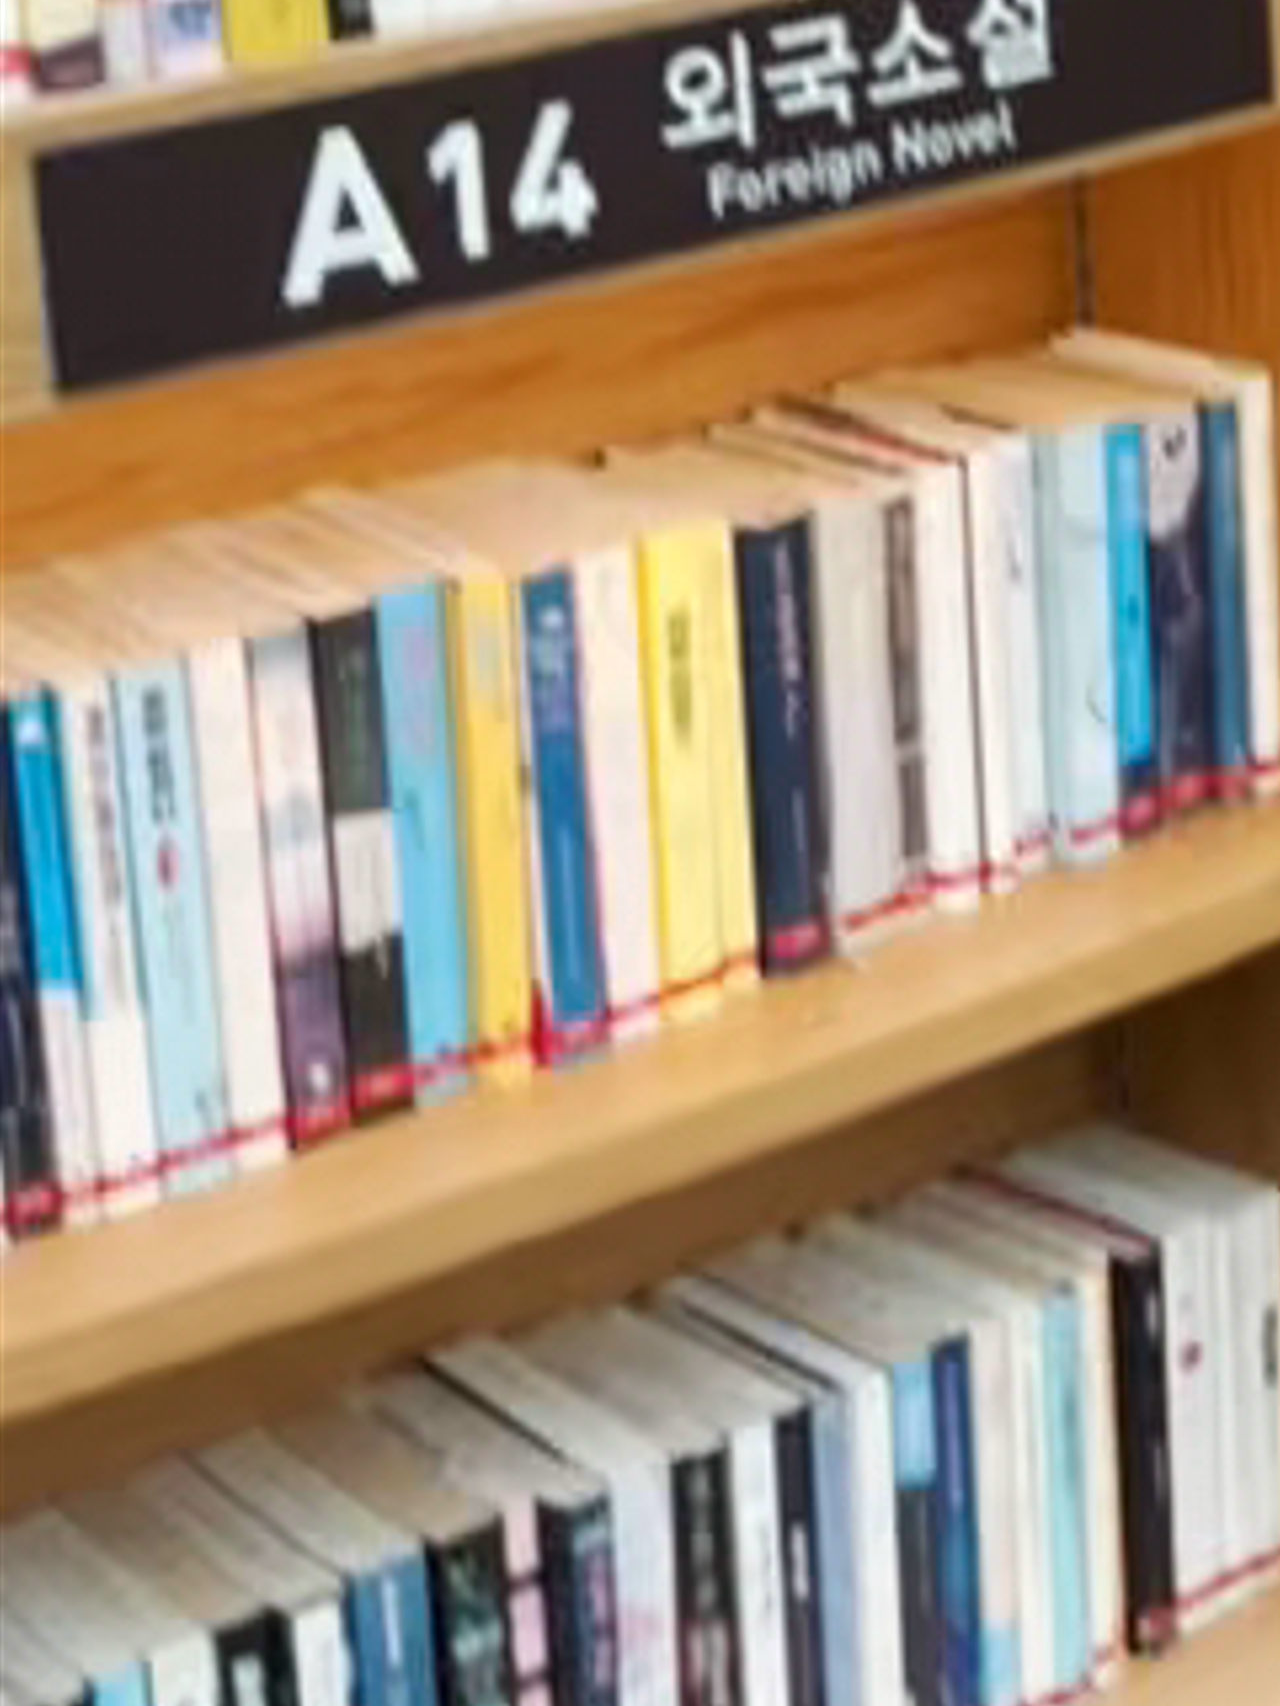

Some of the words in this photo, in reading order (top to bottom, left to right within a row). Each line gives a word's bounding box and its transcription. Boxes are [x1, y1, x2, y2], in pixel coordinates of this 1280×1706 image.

[280, 98, 600, 308] A14
[706, 134, 882, 220] Foreign
[892, 103, 1018, 176] Novel
